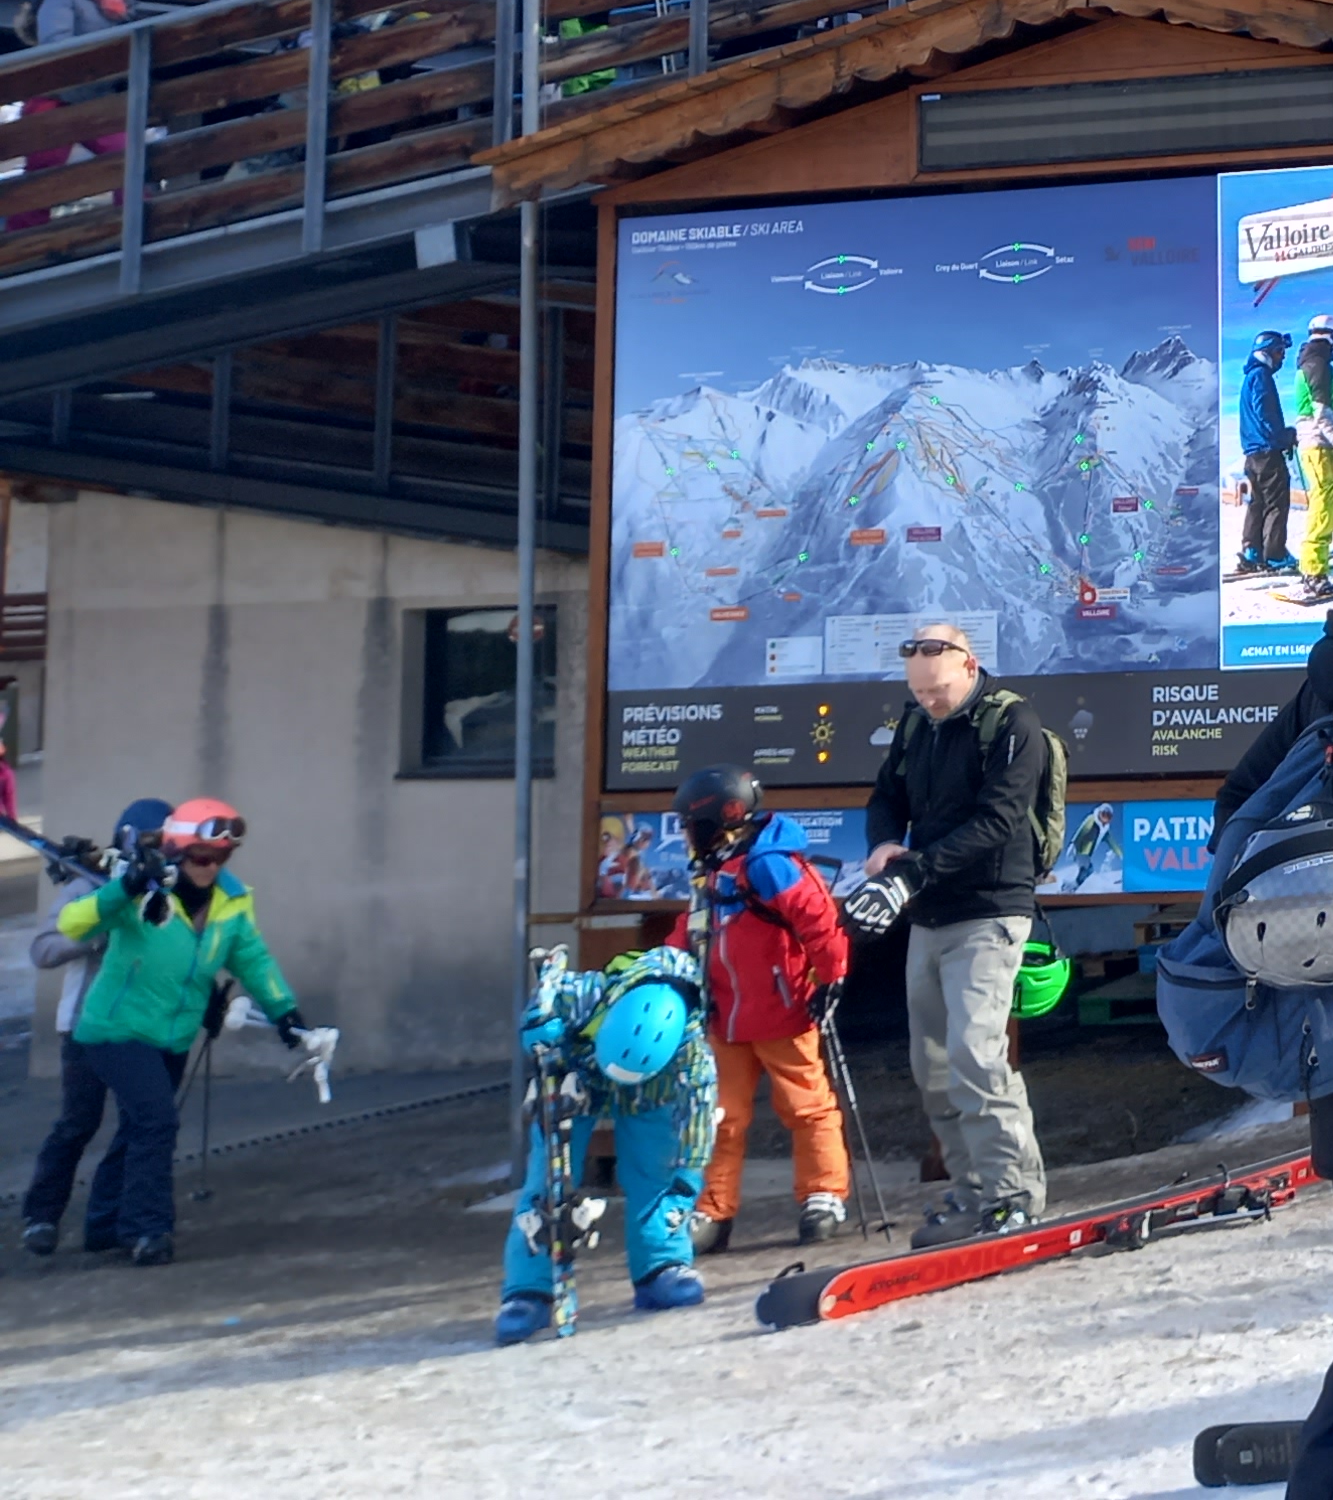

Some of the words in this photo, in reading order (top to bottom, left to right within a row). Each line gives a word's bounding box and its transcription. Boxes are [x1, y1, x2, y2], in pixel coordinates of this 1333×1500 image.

[632, 228, 687, 245] DOMAINE
[689, 224, 742, 241] SKIABLE
[750, 222, 770, 236] SKI
[771, 220, 804, 234] AREA
[1245, 222, 1329, 260] Valloire
[1241, 646, 1273, 657] ACHAT
[1275, 645, 1289, 656] EN
[1291, 644, 1313, 655] LIGN
[1152, 684, 1219, 703] RISQUE
[622, 702, 723, 723] PRÉVISIONS
[1152, 706, 1279, 726] D'AVALANCHE
[622, 725, 681, 746] MÉTÉO
[1152, 728, 1222, 741] AVALANCHE
[622, 746, 677, 759] WEATHER
[1152, 745, 1179, 756] RISK
[621, 760, 680, 773] FORECAST
[1133, 816, 1214, 842] PATIN
[1143, 847, 1211, 871] VALF
